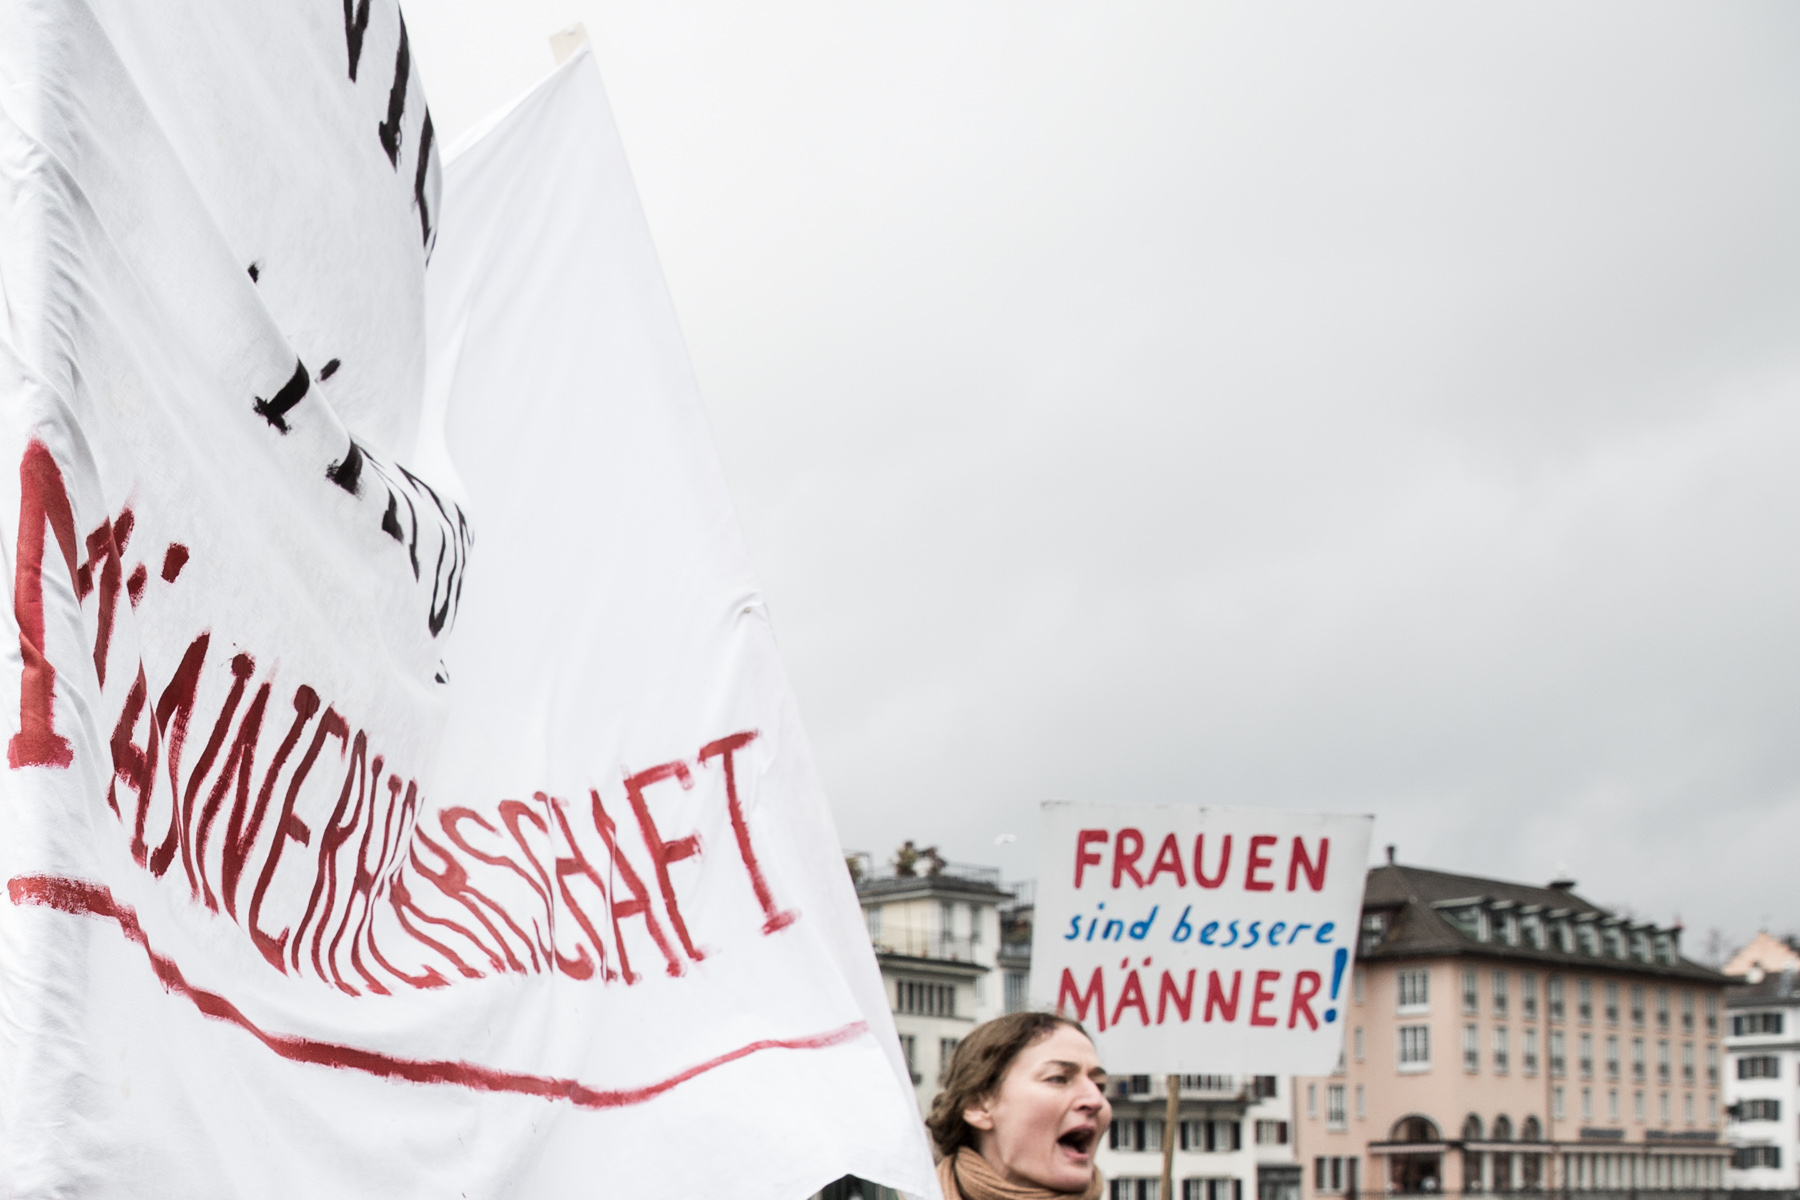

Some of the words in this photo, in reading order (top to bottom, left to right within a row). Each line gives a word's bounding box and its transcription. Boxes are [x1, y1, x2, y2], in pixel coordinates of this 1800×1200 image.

[1073, 827, 1330, 893] FRAUEN
[1064, 902, 1160, 942] sind
[1171, 904, 1336, 949] bessere
[1056, 947, 1349, 1032] MÄNNER!
